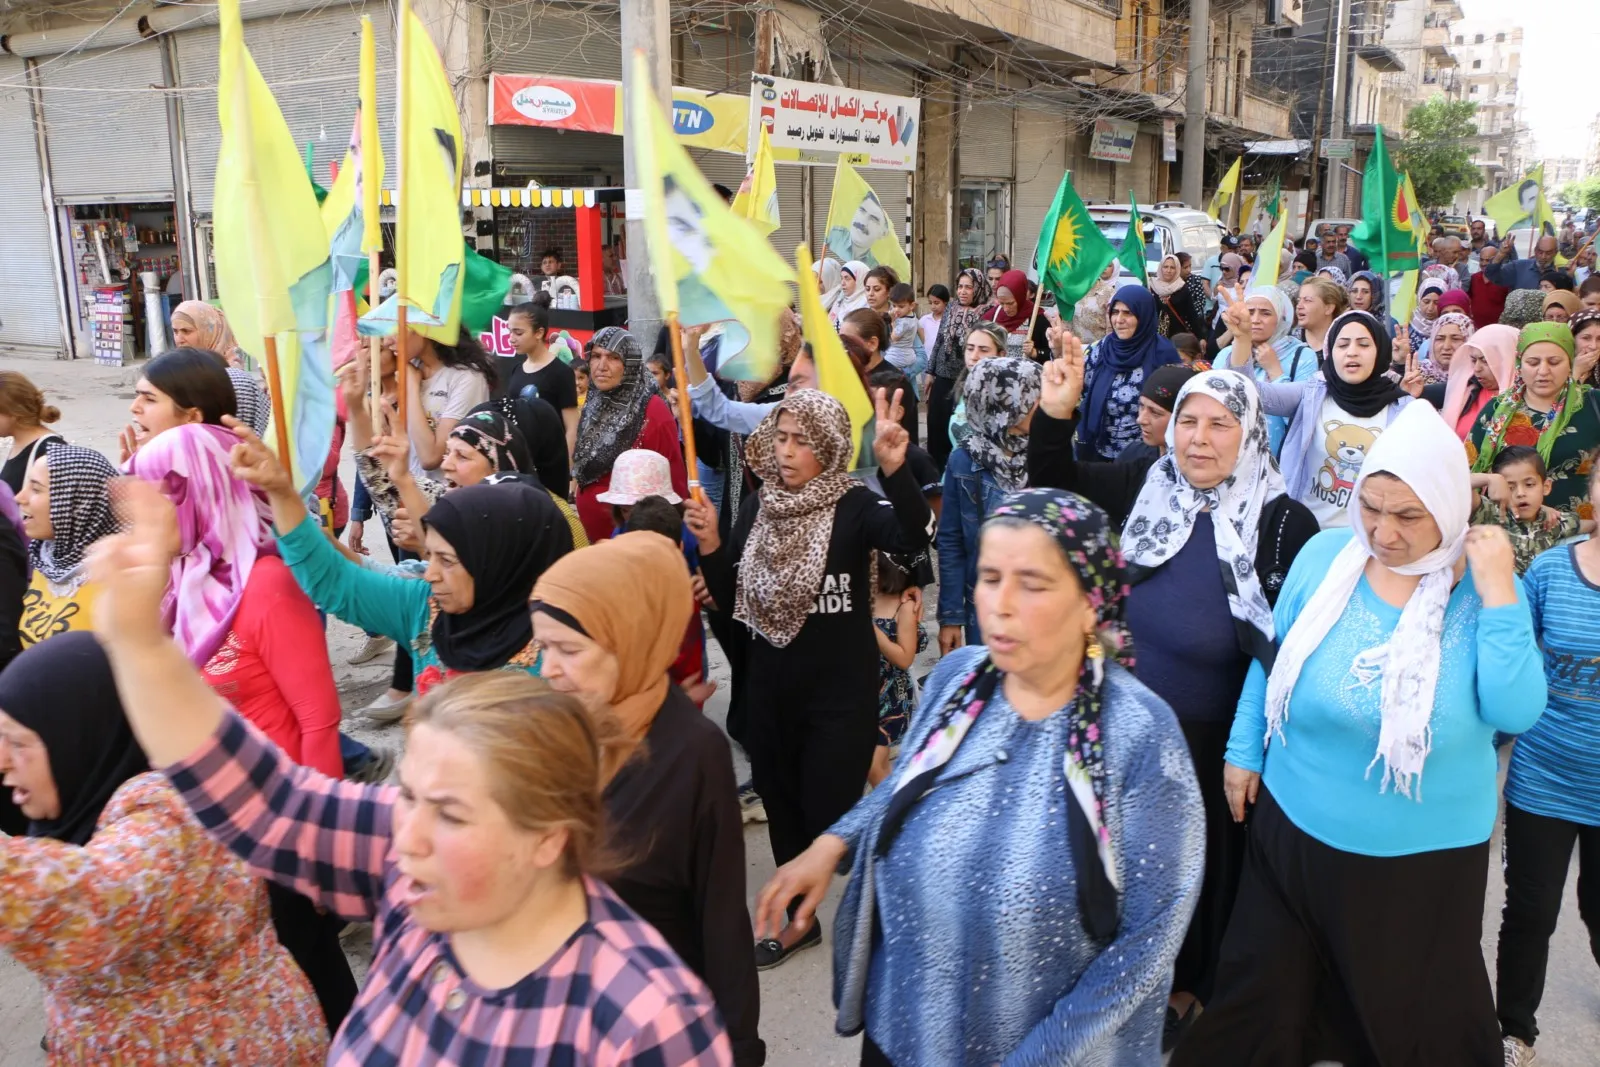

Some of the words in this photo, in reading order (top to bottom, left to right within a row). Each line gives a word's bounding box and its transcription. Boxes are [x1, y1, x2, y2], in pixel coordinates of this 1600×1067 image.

[830, 95, 860, 119] الكمال
[860, 100, 889, 124] مركز
[787, 125, 804, 140] رصيد
[807, 125, 824, 142] تحويل
[864, 130, 880, 146] صيانة
[821, 573, 851, 594] AR
